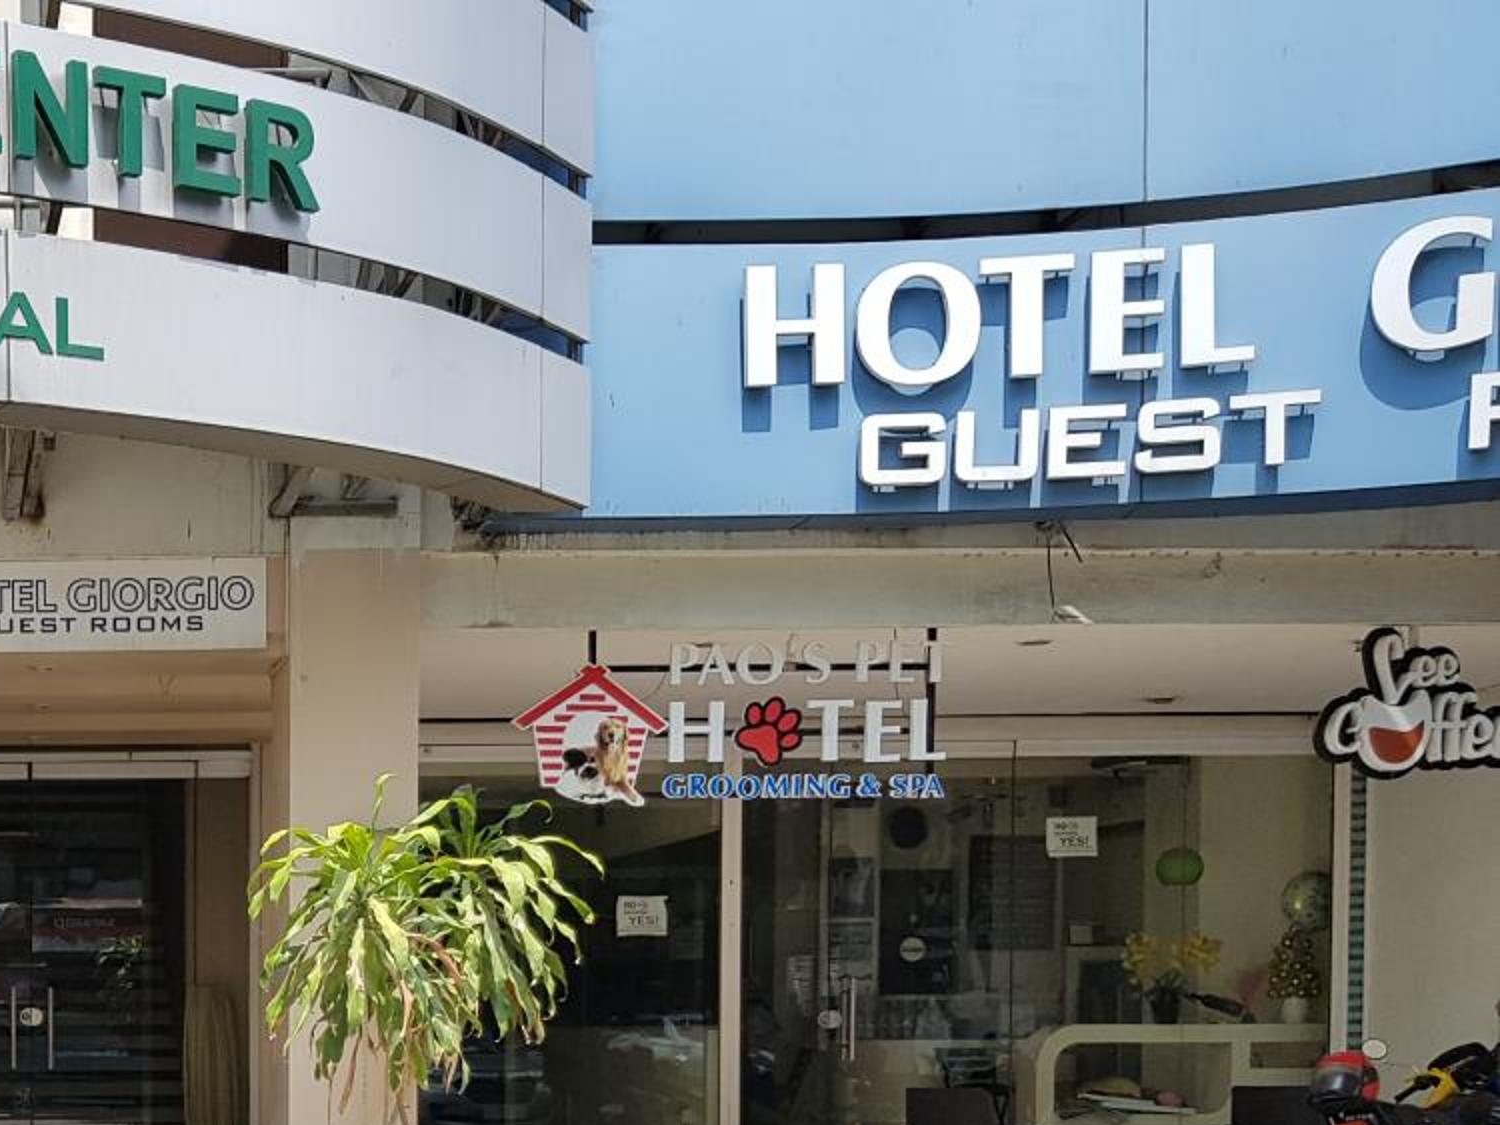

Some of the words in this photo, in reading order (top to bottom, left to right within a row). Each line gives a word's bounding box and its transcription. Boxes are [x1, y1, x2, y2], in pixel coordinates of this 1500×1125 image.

[743, 243, 1256, 388] HOTEL
[858, 388, 1323, 487] GUEST
[66, 575, 255, 614] GIORGIO
[91, 615, 204, 633] ROOMS
[854, 639, 945, 683] PET
[668, 698, 947, 764] HTEL
[661, 772, 852, 799] GROOMING
[856, 774, 882, 797] &
[888, 772, 945, 799] SPA
